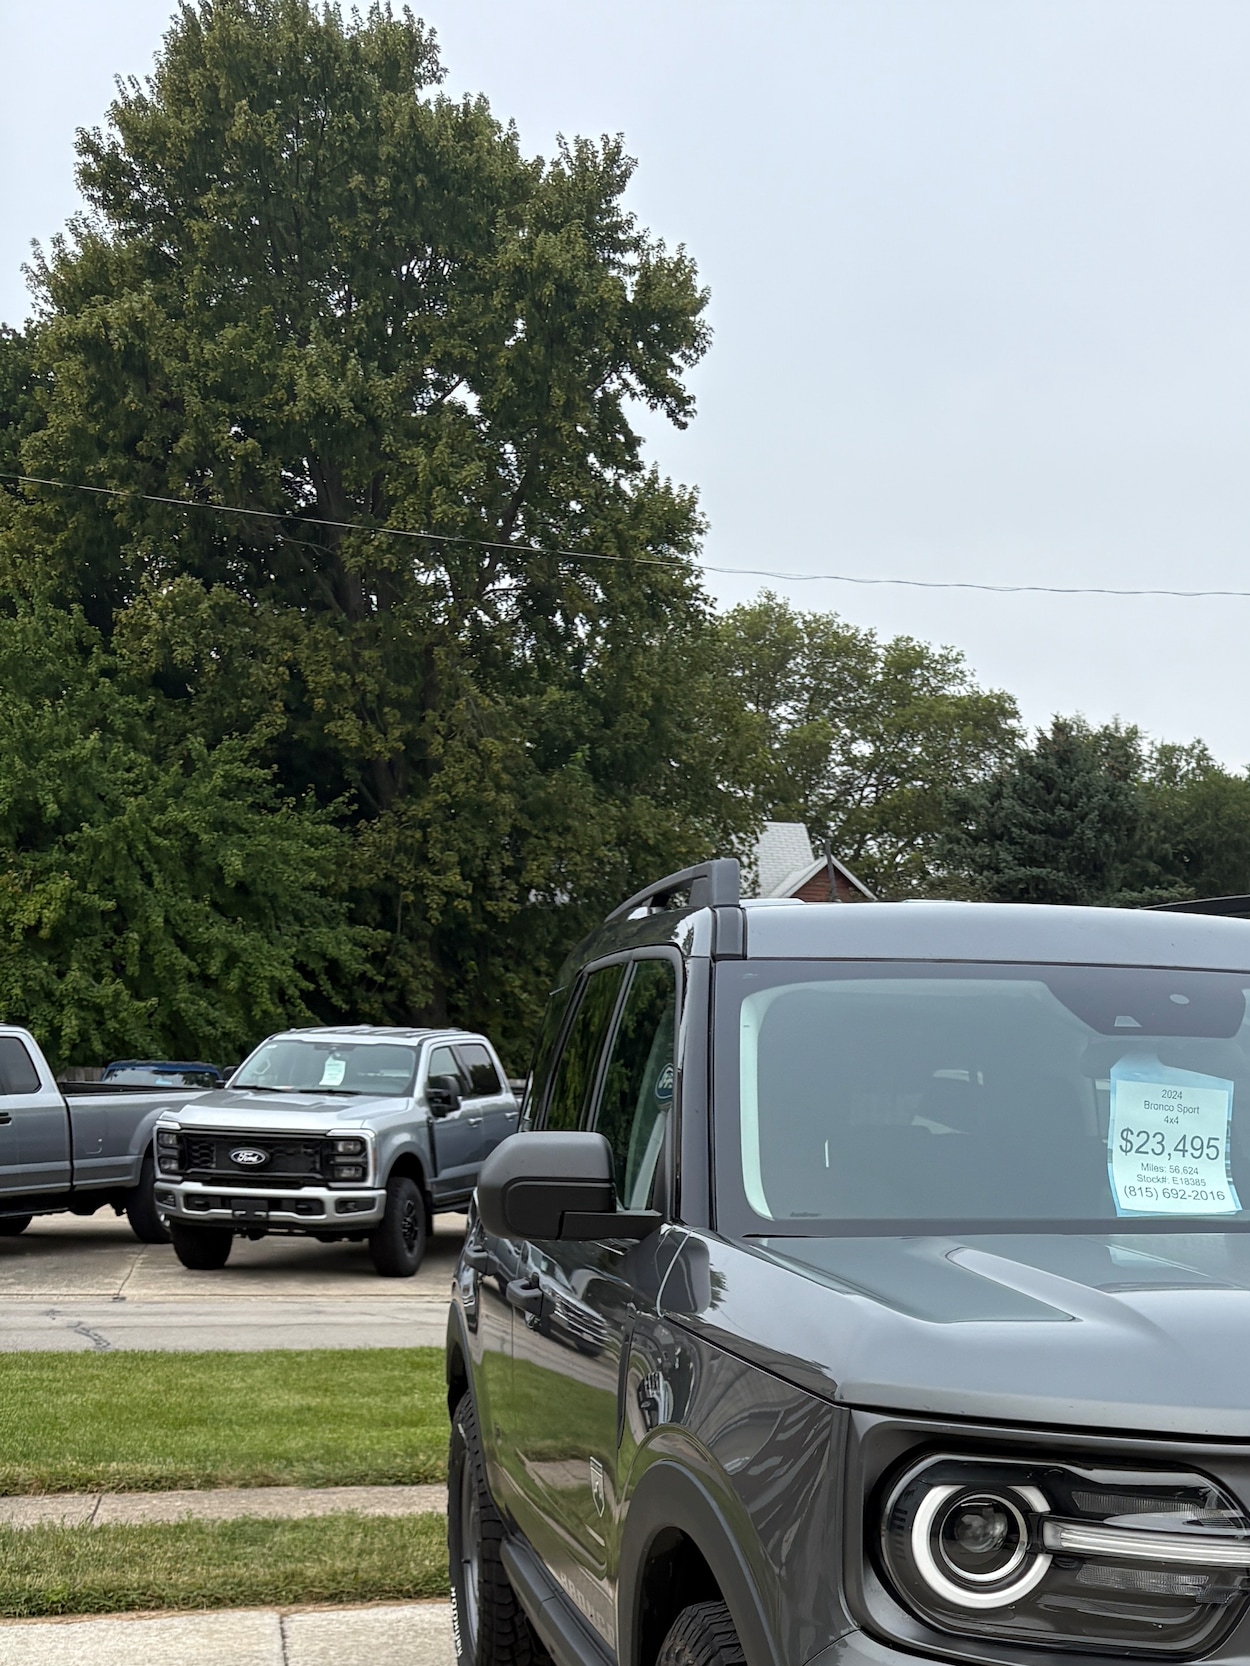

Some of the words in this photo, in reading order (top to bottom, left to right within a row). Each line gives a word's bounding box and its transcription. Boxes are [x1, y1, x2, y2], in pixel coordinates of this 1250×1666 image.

[1161, 1089, 1183, 1100] 2024
[1143, 1100, 1175, 1112] Bronco
[1176, 1103, 1200, 1115] Sport
[1163, 1115, 1179, 1125] 4x4
[1118, 1127, 1220, 1161] $23,495
[1140, 1162, 1167, 1173] Miles:
[1168, 1165, 1199, 1175] 56,624
[1136, 1173, 1170, 1185] Stock#:
[1172, 1176, 1206, 1187] E18385
[1123, 1185, 1159, 1200] (815)
[1162, 1187, 1225, 1201] 692-2016
